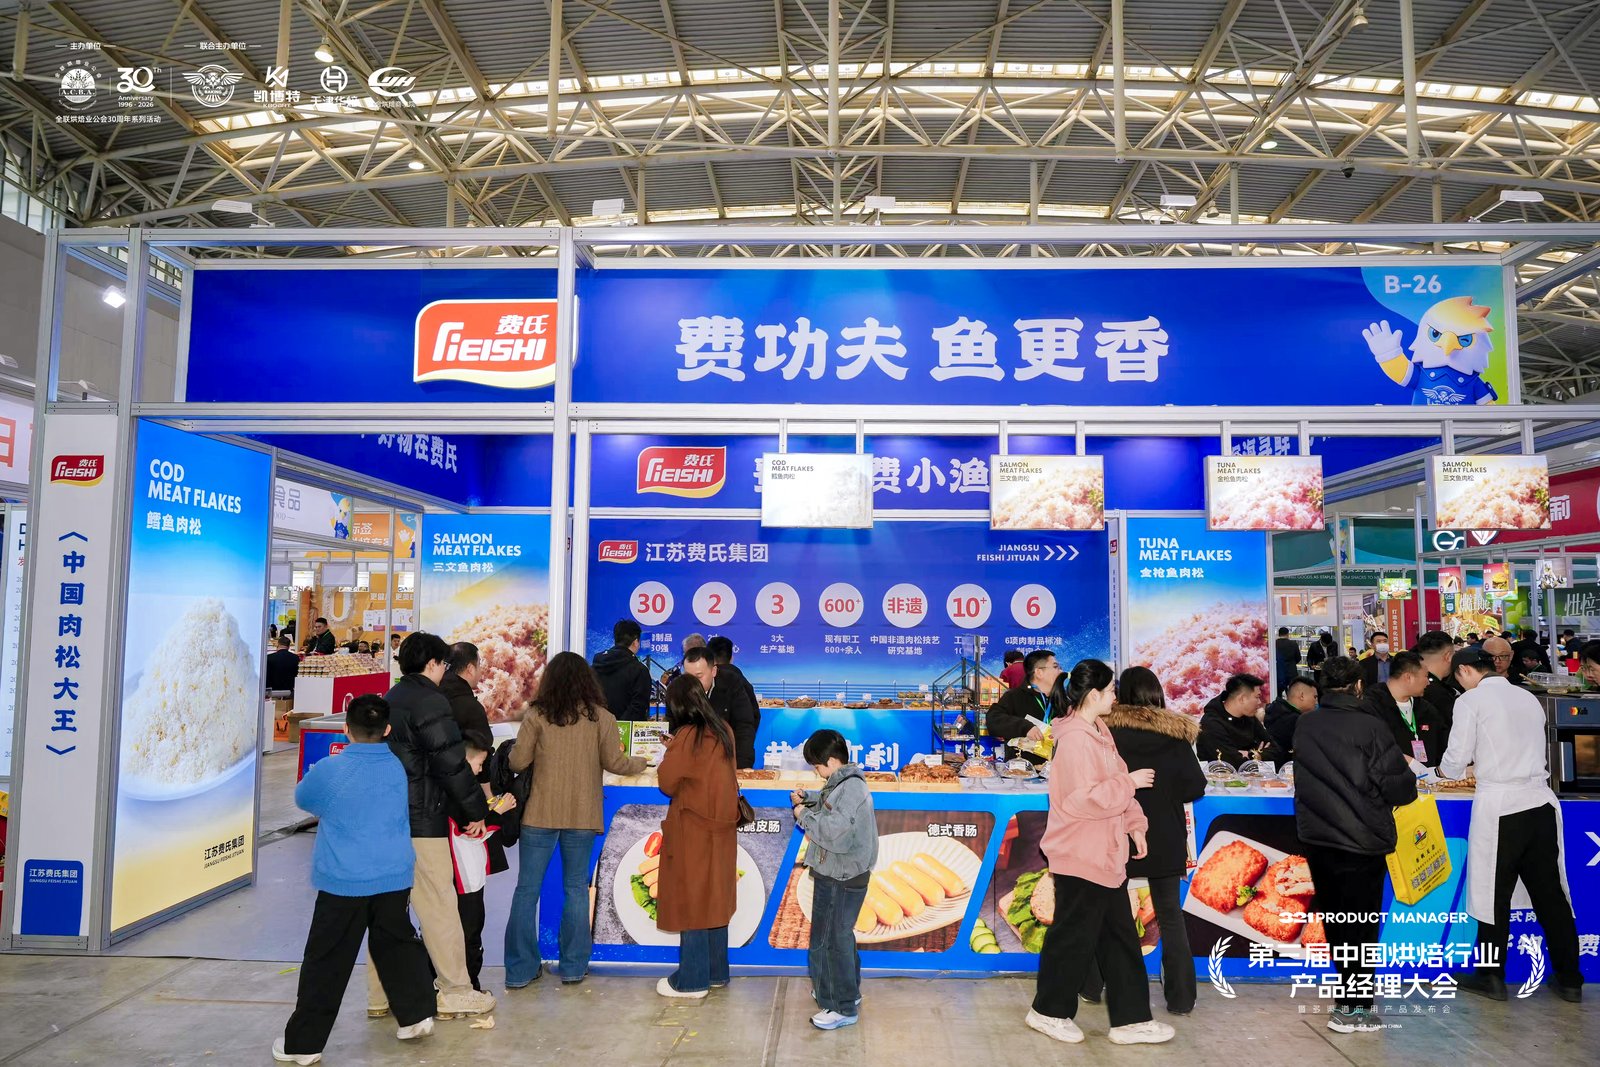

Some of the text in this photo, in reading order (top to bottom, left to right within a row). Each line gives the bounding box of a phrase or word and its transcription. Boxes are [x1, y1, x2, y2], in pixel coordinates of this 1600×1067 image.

[1384, 275, 1442, 293] B-26
[495, 314, 550, 335] 费氏
[675, 314, 1170, 383] 费功夫 鱼更香
[683, 453, 714, 467] 费氏
[150, 459, 185, 482] COD
[148, 480, 241, 514] MEAT FLAKES
[146, 510, 202, 536] 鳕鱼肉松
[433, 533, 493, 544] SALMON
[1138, 537, 1179, 549] TUNA
[433, 545, 521, 556] MEAT FLAKES
[645, 542, 769, 563] 江苏费氏集团
[1139, 550, 1233, 561] MEAT FLAKES
[977, 554, 1040, 562] FEISHI JITUAN
[433, 562, 494, 573] 三文鱼肉松
[1140, 567, 1204, 578] 金枪鱼肉松
[637, 593, 666, 614] 30
[708, 594, 721, 614] 2
[771, 594, 785, 615] 3
[824, 597, 861, 613] 600+
[887, 597, 923, 614] 非遗
[952, 596, 987, 618] 10+
[1026, 596, 1041, 617] 6
[771, 635, 784, 643] 3大
[824, 635, 860, 644] 现有职工
[870, 635, 940, 645] 中国非遗肉松技艺
[1004, 636, 1063, 645] 6项肉制品标准
[760, 645, 795, 654] 生产基地
[824, 646, 862, 655] 600+余人
[887, 646, 923, 656] 研究基地
[927, 823, 977, 838] 德式香肠
[204, 834, 245, 861] 江苏费氏集团
[29, 868, 78, 878] 江苏费氏集团
